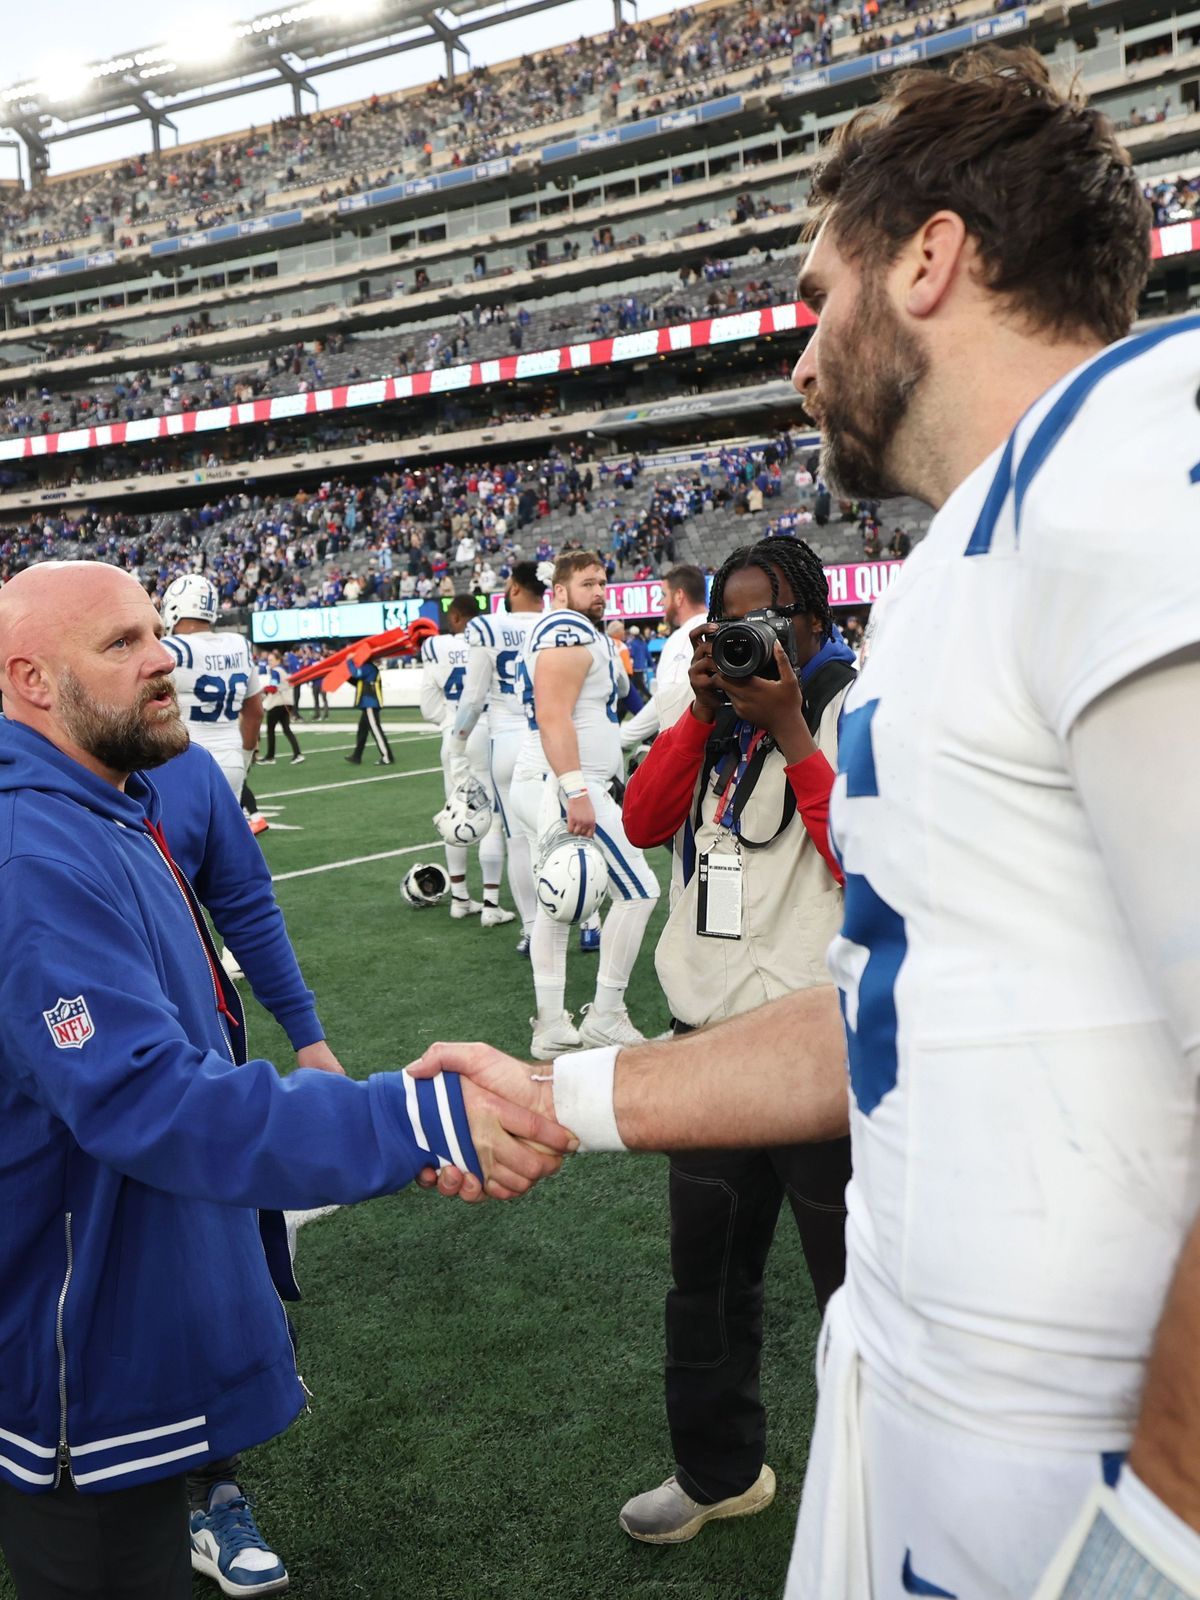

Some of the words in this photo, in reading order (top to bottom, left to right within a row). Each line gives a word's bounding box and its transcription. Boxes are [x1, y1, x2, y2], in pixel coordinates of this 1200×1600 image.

[649, 401, 712, 416] MetLife
[206, 470, 232, 479] MetLife
[623, 586, 648, 614] ON
[205, 652, 243, 671] STEWART
[448, 650, 470, 665] SPE
[189, 672, 249, 723] 90
[54, 1016, 90, 1044] NFL
